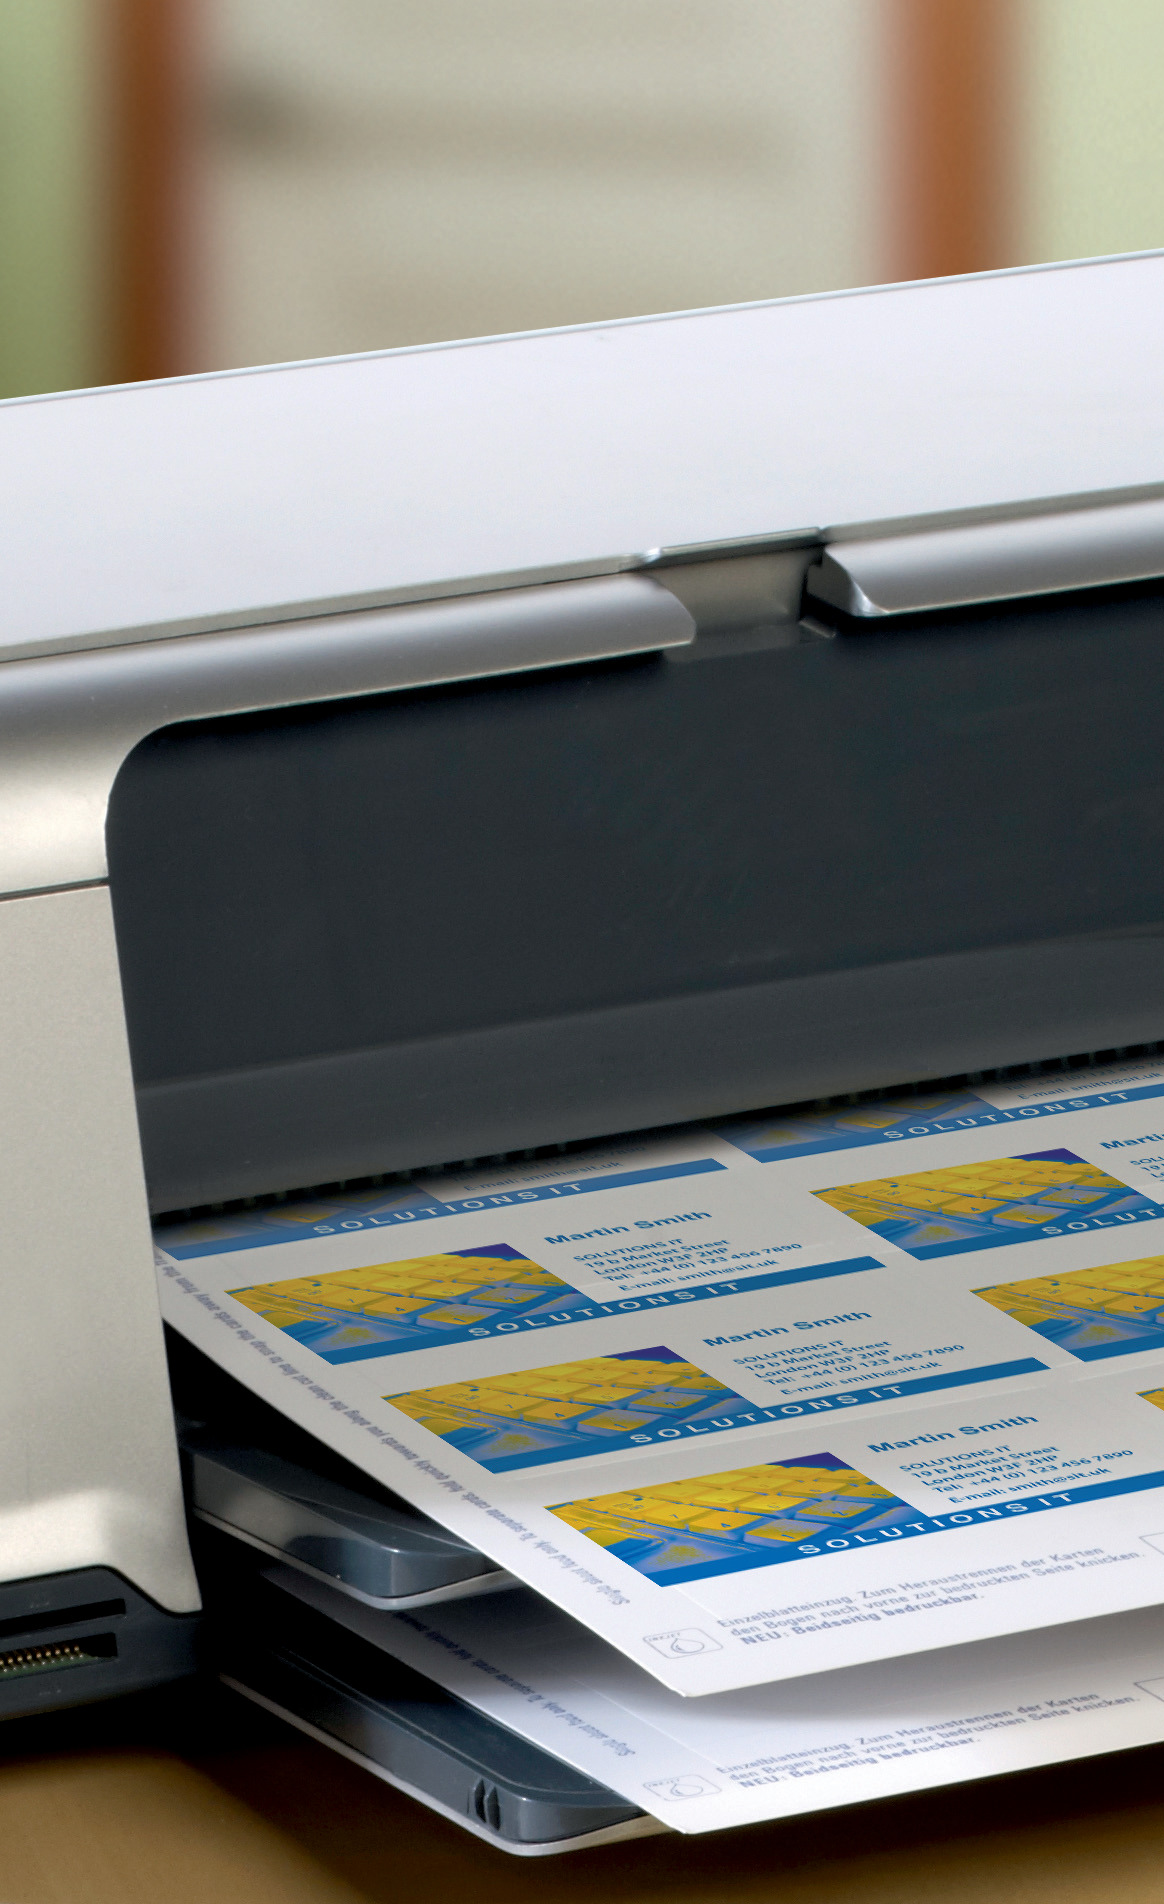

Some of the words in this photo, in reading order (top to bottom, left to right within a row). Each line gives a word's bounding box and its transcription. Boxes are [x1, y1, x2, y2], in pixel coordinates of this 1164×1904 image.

[882, 1099, 1090, 1139] SOLUTIONS
[1097, 1092, 1129, 1104] IT
[313, 1191, 539, 1234] SOLUTIONS
[548, 1182, 582, 1195] IT
[543, 1226, 631, 1245] Martin
[633, 1211, 713, 1229] Smith
[468, 1291, 696, 1337] SOLUTIONS
[705, 1282, 739, 1295] IT
[702, 1327, 790, 1347] Martin
[792, 1312, 873, 1330] Smith
[733, 1343, 828, 1365] SOLUTIONS
[754, 1363, 819, 1379] London
[781, 1350, 841, 1365] Market
[840, 1341, 892, 1353] Street
[629, 1395, 859, 1443] SOLUTIONS
[868, 1385, 902, 1399] IT
[867, 1432, 956, 1453] Martin
[958, 1415, 1039, 1435] Smith
[899, 1449, 995, 1472] SOLUTIONS
[995, 1445, 1011, 1453] IT
[948, 1456, 1009, 1472] Market
[1008, 1446, 1060, 1459] Street
[920, 1470, 987, 1487] London
[797, 1503, 1029, 1554] SOLUTIONS
[1037, 1492, 1072, 1507] IT
[857, 1587, 897, 1600] Zum
[897, 1564, 1018, 1592] Heraustrennen
[1020, 1558, 1046, 1568] der
[1048, 1547, 1105, 1563] Karten
[730, 1625, 762, 1637] den
[762, 1614, 817, 1630] Bogen
[819, 1604, 860, 1619] nach
[863, 1596, 910, 1609] vorne
[913, 1590, 937, 1600] zur
[1031, 1564, 1075, 1577] Seite
